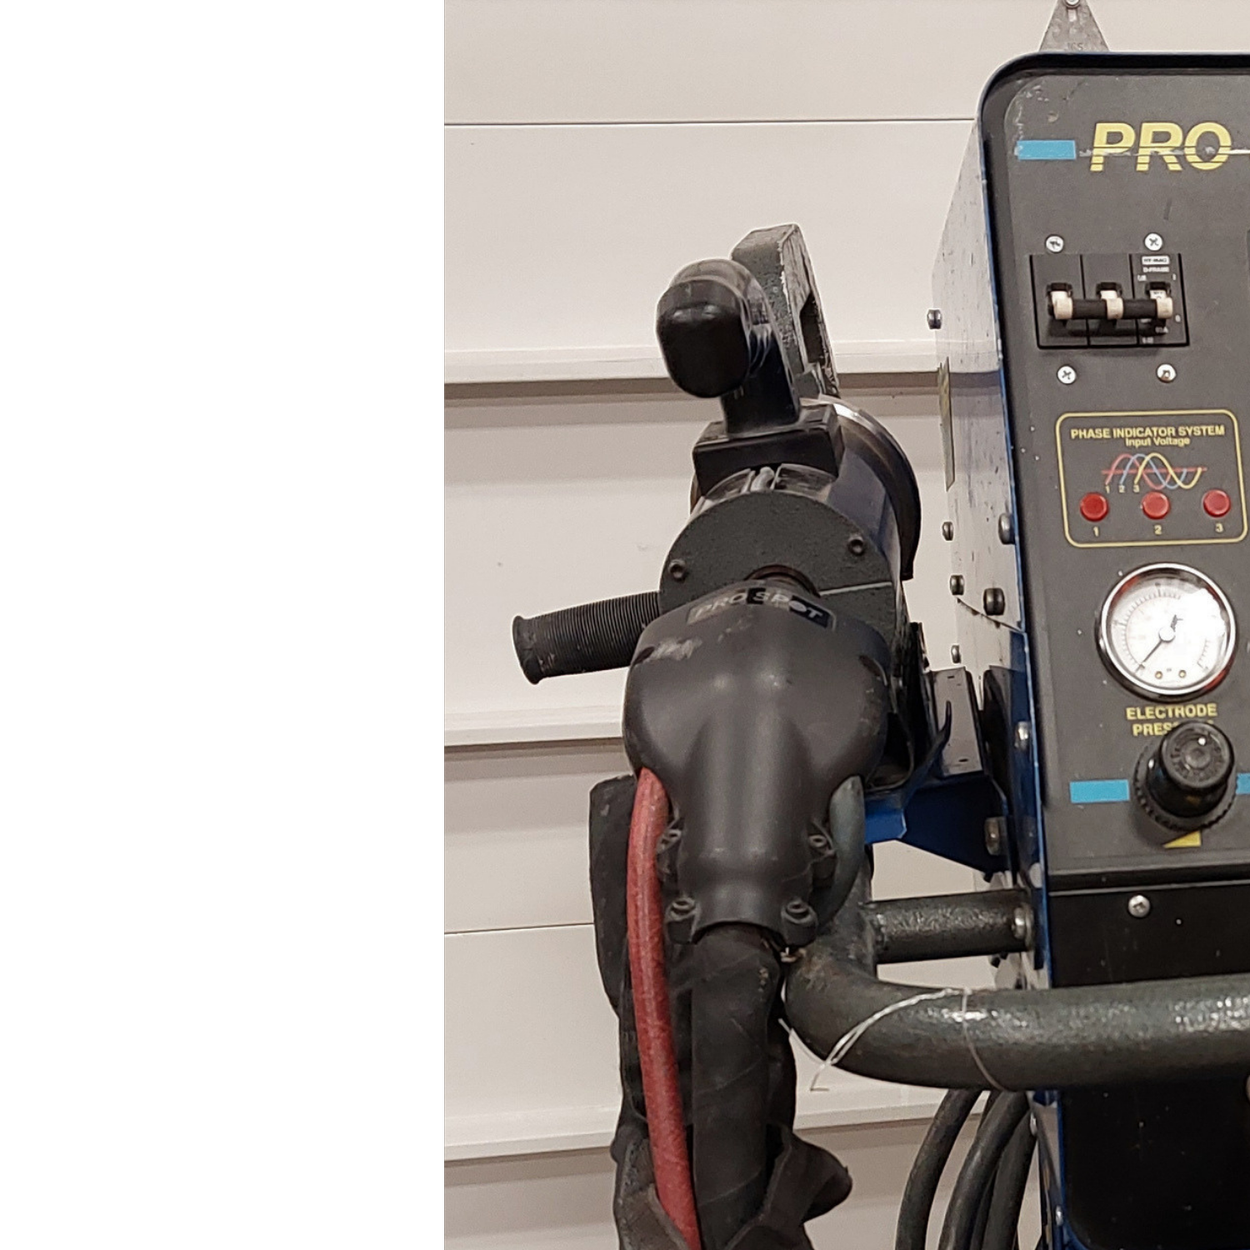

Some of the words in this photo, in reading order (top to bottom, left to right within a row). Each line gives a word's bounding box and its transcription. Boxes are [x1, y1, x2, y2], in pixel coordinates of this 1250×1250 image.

[1089, 121, 1232, 172] PRO
[1070, 427, 1111, 439] PHASE
[1113, 426, 1175, 438] INDICATOR
[1178, 425, 1225, 436] SYSTEM
[1125, 437, 1151, 448] Input
[1153, 435, 1191, 448] Voltage
[1093, 526, 1100, 537] 1
[1154, 524, 1162, 535] 2
[1215, 523, 1223, 533] 3
[753, 591, 823, 619] SPOT
[1126, 703, 1218, 720] ELECTRODE
